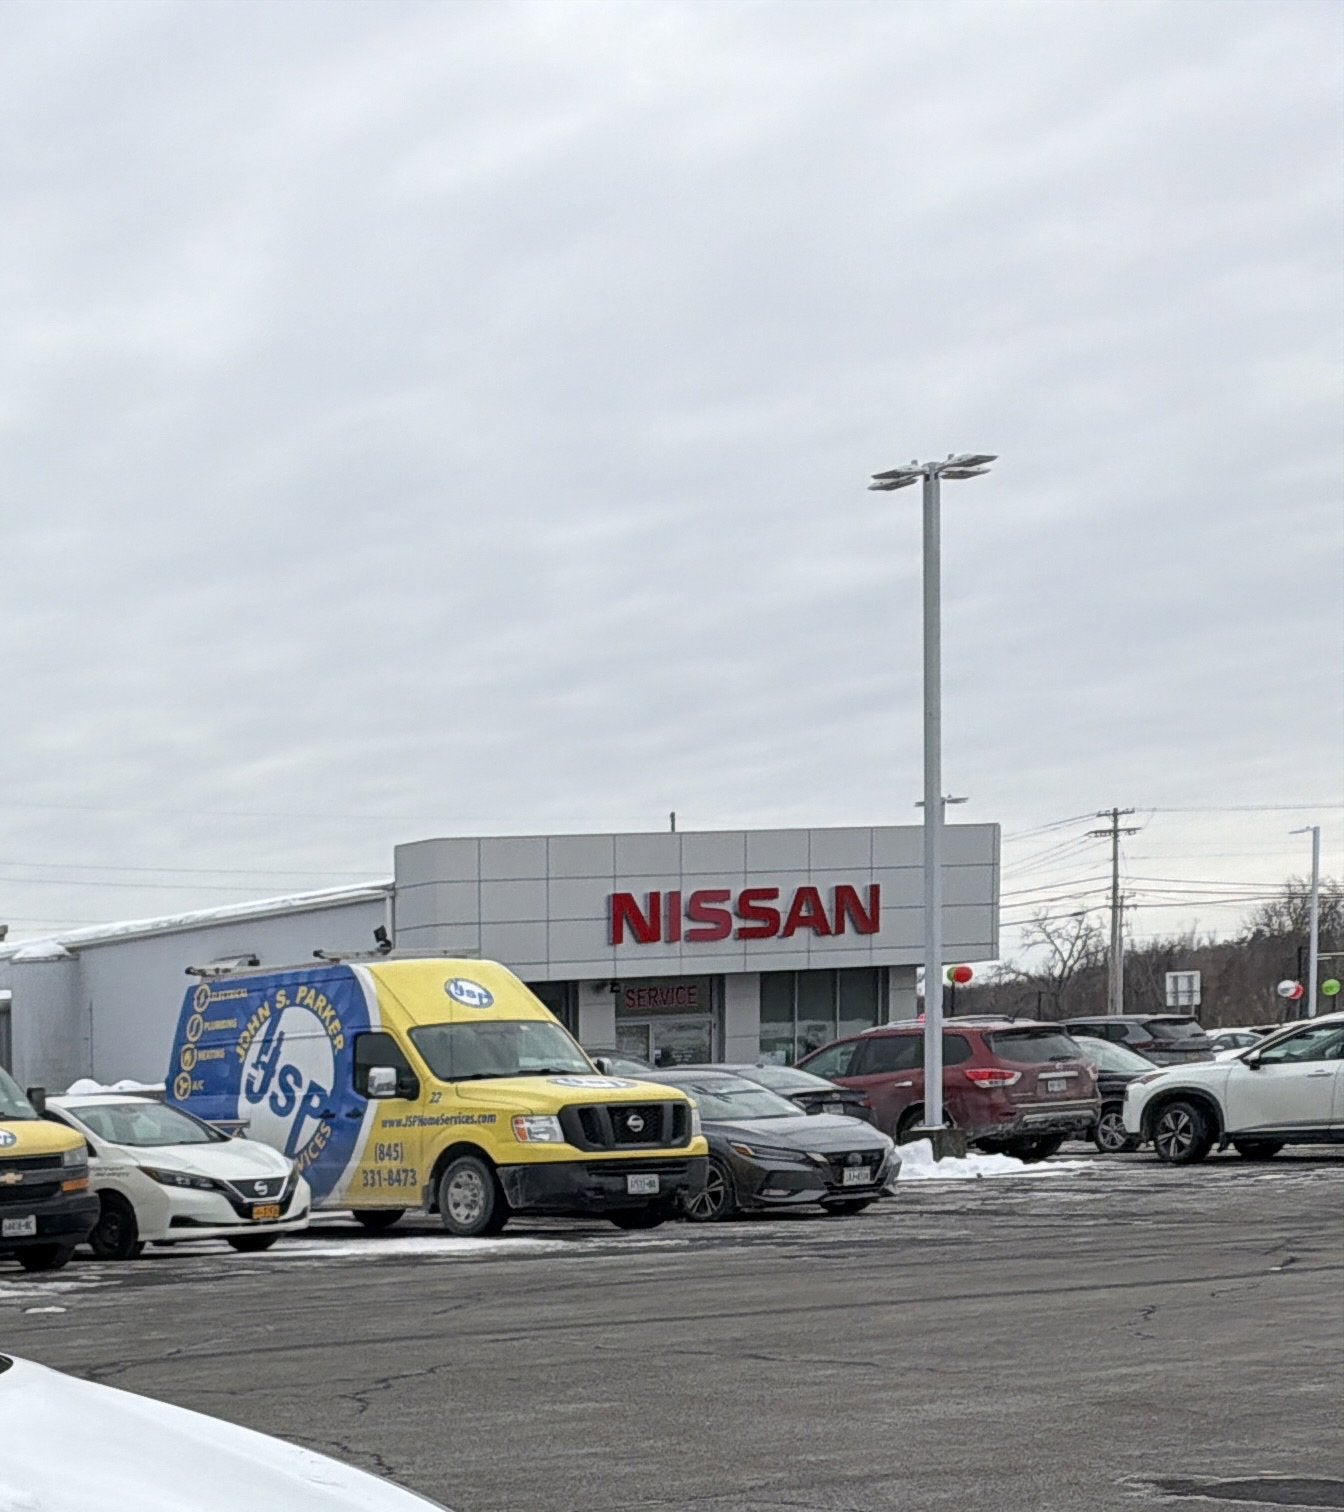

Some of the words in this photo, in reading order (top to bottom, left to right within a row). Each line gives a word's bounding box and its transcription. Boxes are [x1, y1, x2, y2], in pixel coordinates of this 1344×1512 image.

[610, 883, 880, 945] NISSAN
[625, 986, 698, 1009] SERVICE
[236, 1000, 271, 1063] JOHN
[275, 989, 291, 1009] S.
[296, 985, 345, 1056] PARKER
[245, 1007, 332, 1158] JSP
[429, 1091, 442, 1104] 22
[381, 1113, 497, 1129] www.JSPHomeServices.com
[297, 1121, 332, 1172] VICES
[375, 1142, 404, 1164] (845)
[362, 1168, 417, 1188] 331-8473
